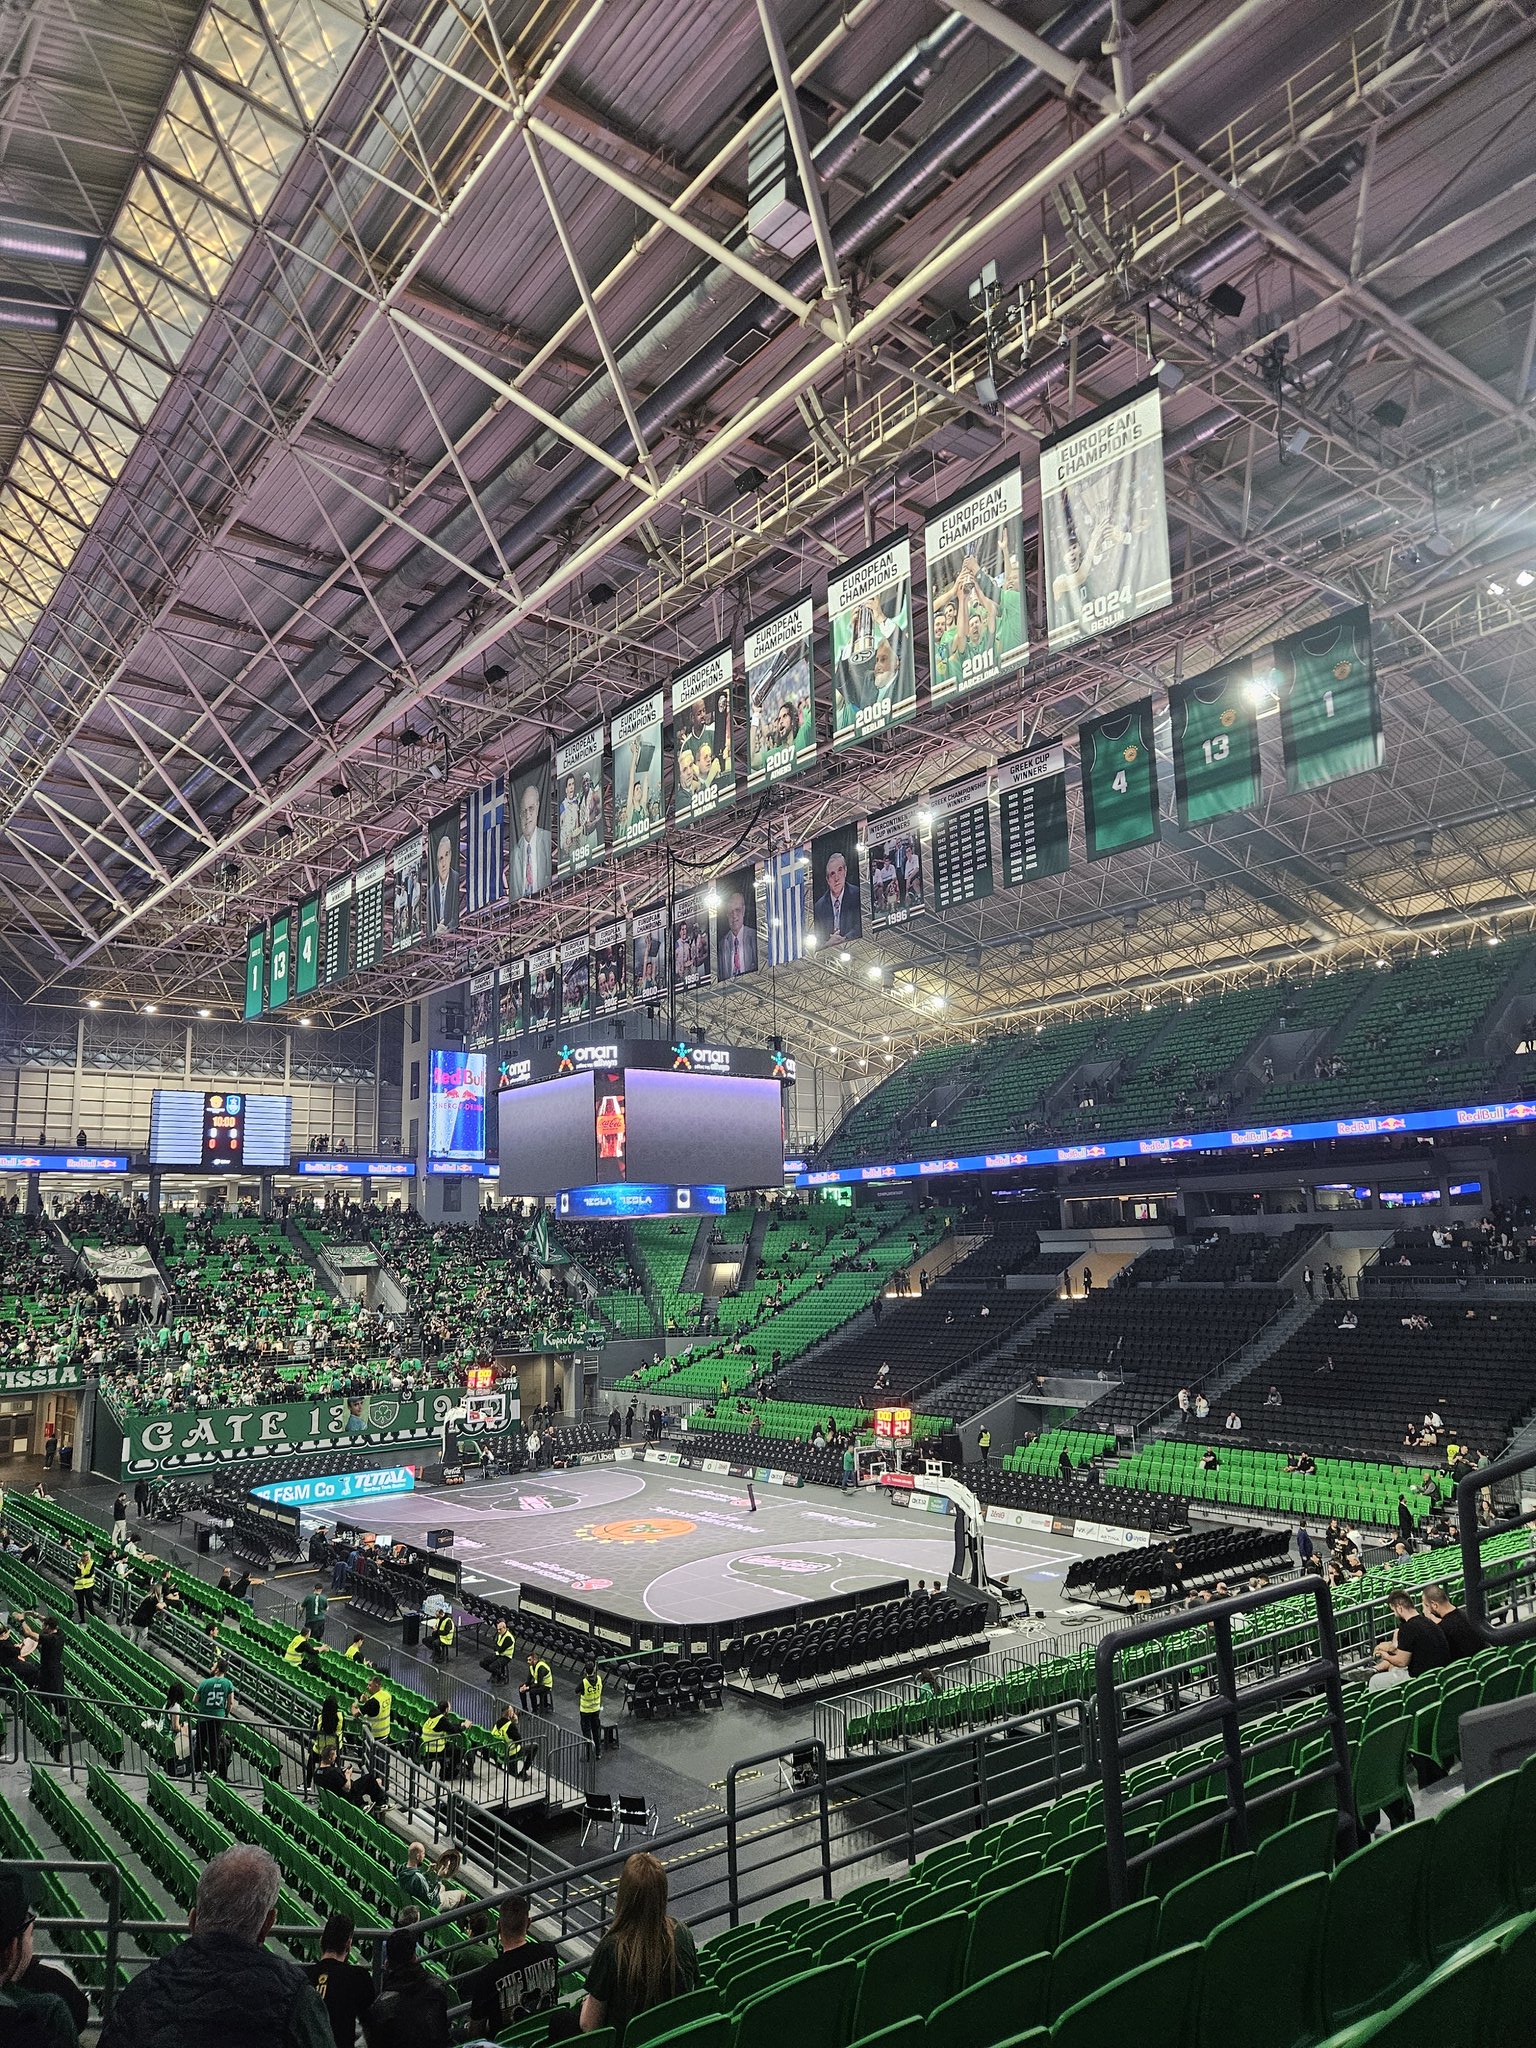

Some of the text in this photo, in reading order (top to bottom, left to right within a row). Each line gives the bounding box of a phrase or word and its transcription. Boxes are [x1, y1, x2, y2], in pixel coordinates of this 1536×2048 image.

[1060, 410, 1136, 462] EUROPEAN
[1057, 425, 1142, 480] CHAMPIONS
[941, 487, 1002, 533] EUROPEAN
[938, 500, 1007, 550] CHAMPIONS
[842, 551, 894, 592] EUROPEAN
[839, 564, 898, 607] CHAMPIONS
[1081, 584, 1132, 622] 2024
[756, 609, 799, 645] EUROPEAN
[1091, 610, 1125, 632] BERLIN
[753, 623, 803, 659] CHAMPIONS
[682, 659, 721, 691] EUROPEAN
[962, 648, 994, 679] 2011
[680, 669, 724, 704] CHAMPIONS
[958, 666, 1000, 692] BARCELONA
[620, 701, 654, 728] EUROPEAN
[855, 697, 891, 729] 2009
[1324, 690, 1335, 718] 1
[618, 711, 657, 739] CHAMPIONS
[862, 717, 885, 736] BERLIN
[563, 743, 598, 770] CHAMPIONS
[565, 733, 596, 758] EUROPEAN
[766, 745, 795, 772] 2007
[1202, 733, 1230, 764] 13
[1010, 753, 1050, 775] GREEK CUP
[1013, 763, 1048, 782] WINNERS
[948, 781, 987, 801] CHAMPIONSHIP
[1112, 769, 1128, 793] 4
[692, 783, 718, 809] 2002
[947, 794, 971, 808] WINNERS
[626, 817, 650, 840] 2000
[875, 821, 911, 839] CUP WINNERS
[572, 843, 590, 863] 1996
[887, 910, 908, 925] 1996
[302, 935, 312, 963] 4
[252, 965, 258, 992] 1
[274, 950, 286, 981] 13
[434, 1067, 461, 1086] Red
[212, 1116, 236, 1127] 10:00
[208, 1138, 238, 1149] 0 0
[141, 1411, 287, 1452] GATE
[308, 1406, 343, 1435] 13
[876, 1421, 891, 1435] 24
[895, 1420, 910, 1435] 24
[598, 1452, 615, 1461] Uber
[274, 1484, 310, 1502] F&M
[315, 1482, 335, 1497] Co
[206, 1692, 224, 1706] 25
[587, 1685, 601, 1694] CSI
